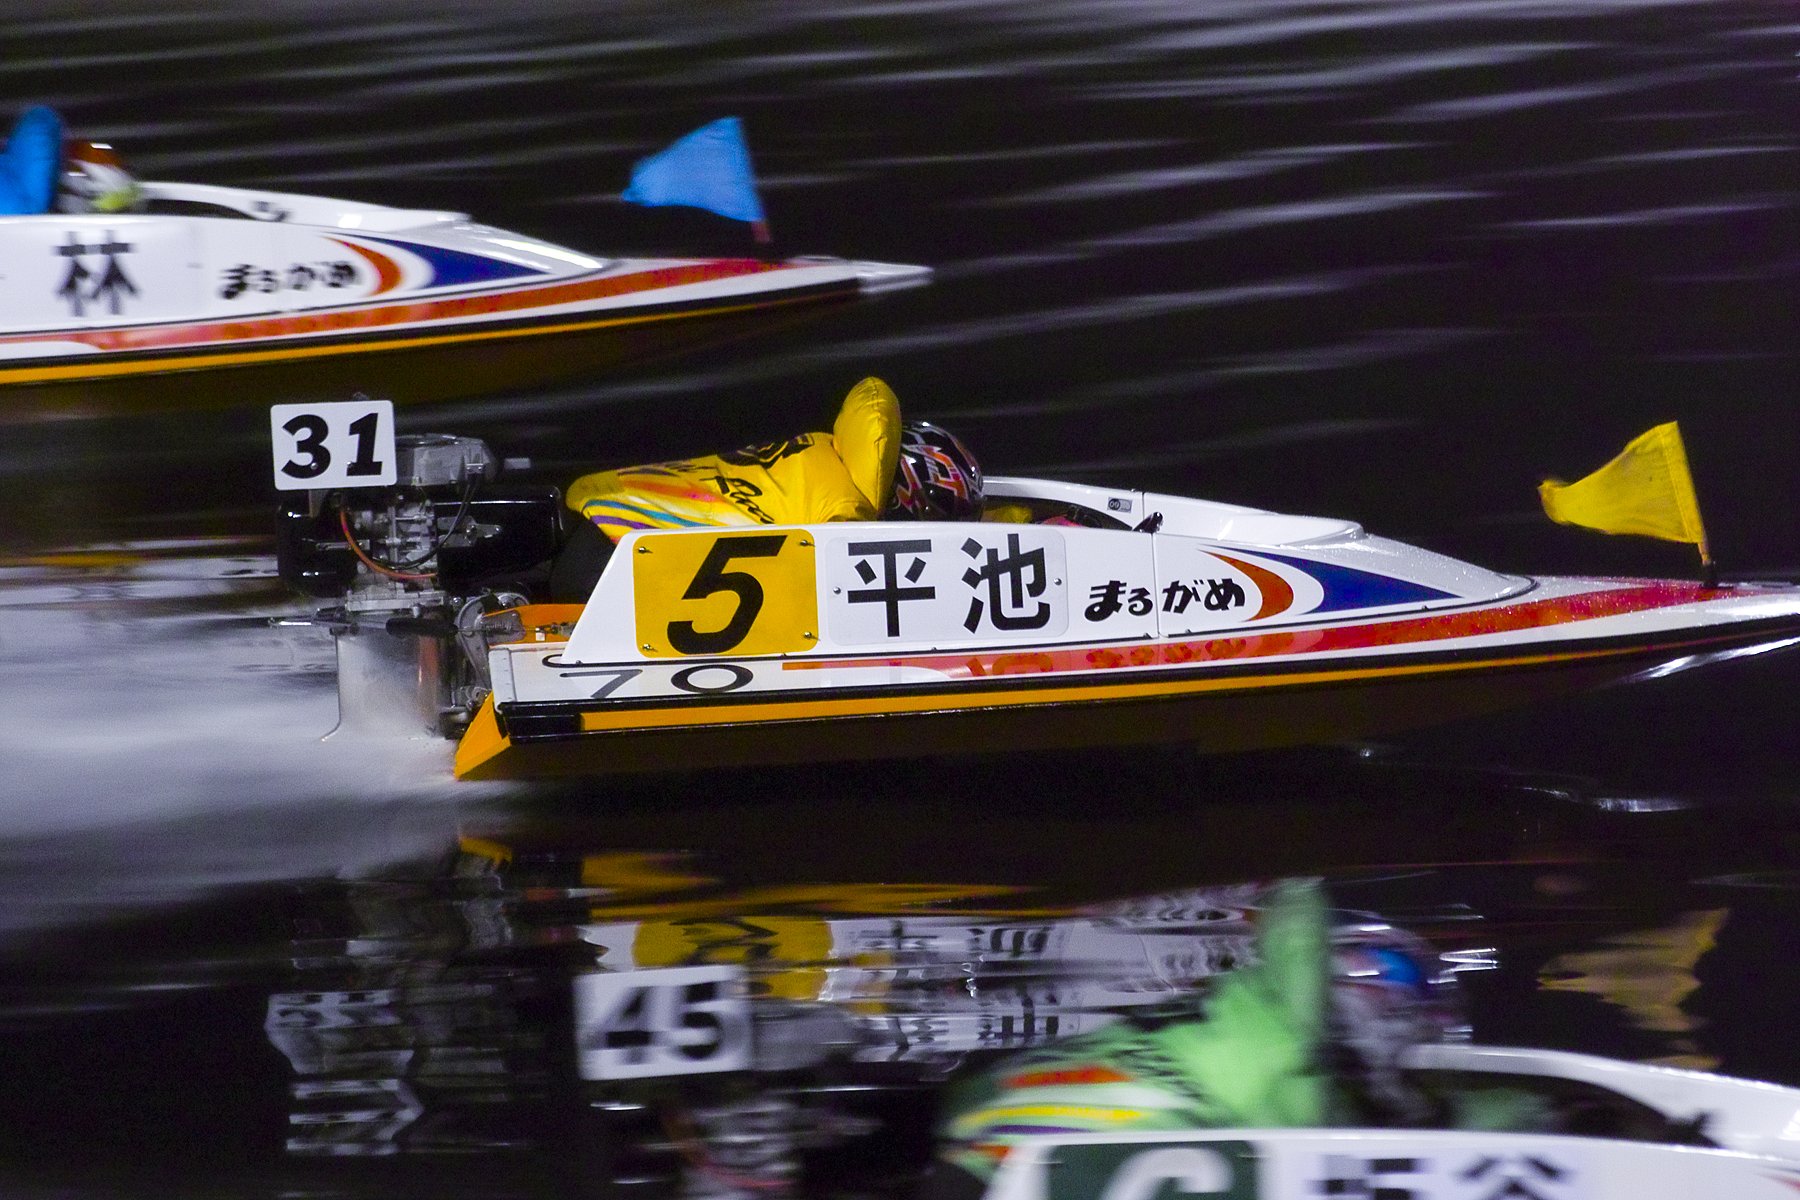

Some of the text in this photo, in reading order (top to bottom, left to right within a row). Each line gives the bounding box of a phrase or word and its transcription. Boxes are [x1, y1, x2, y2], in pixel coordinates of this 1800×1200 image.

[53, 230, 138, 316] 林
[281, 412, 383, 479] 31
[666, 535, 788, 655] 5
[847, 533, 1051, 637] 平池
[1084, 578, 1246, 622] まるがめ
[594, 980, 728, 1064] 45
